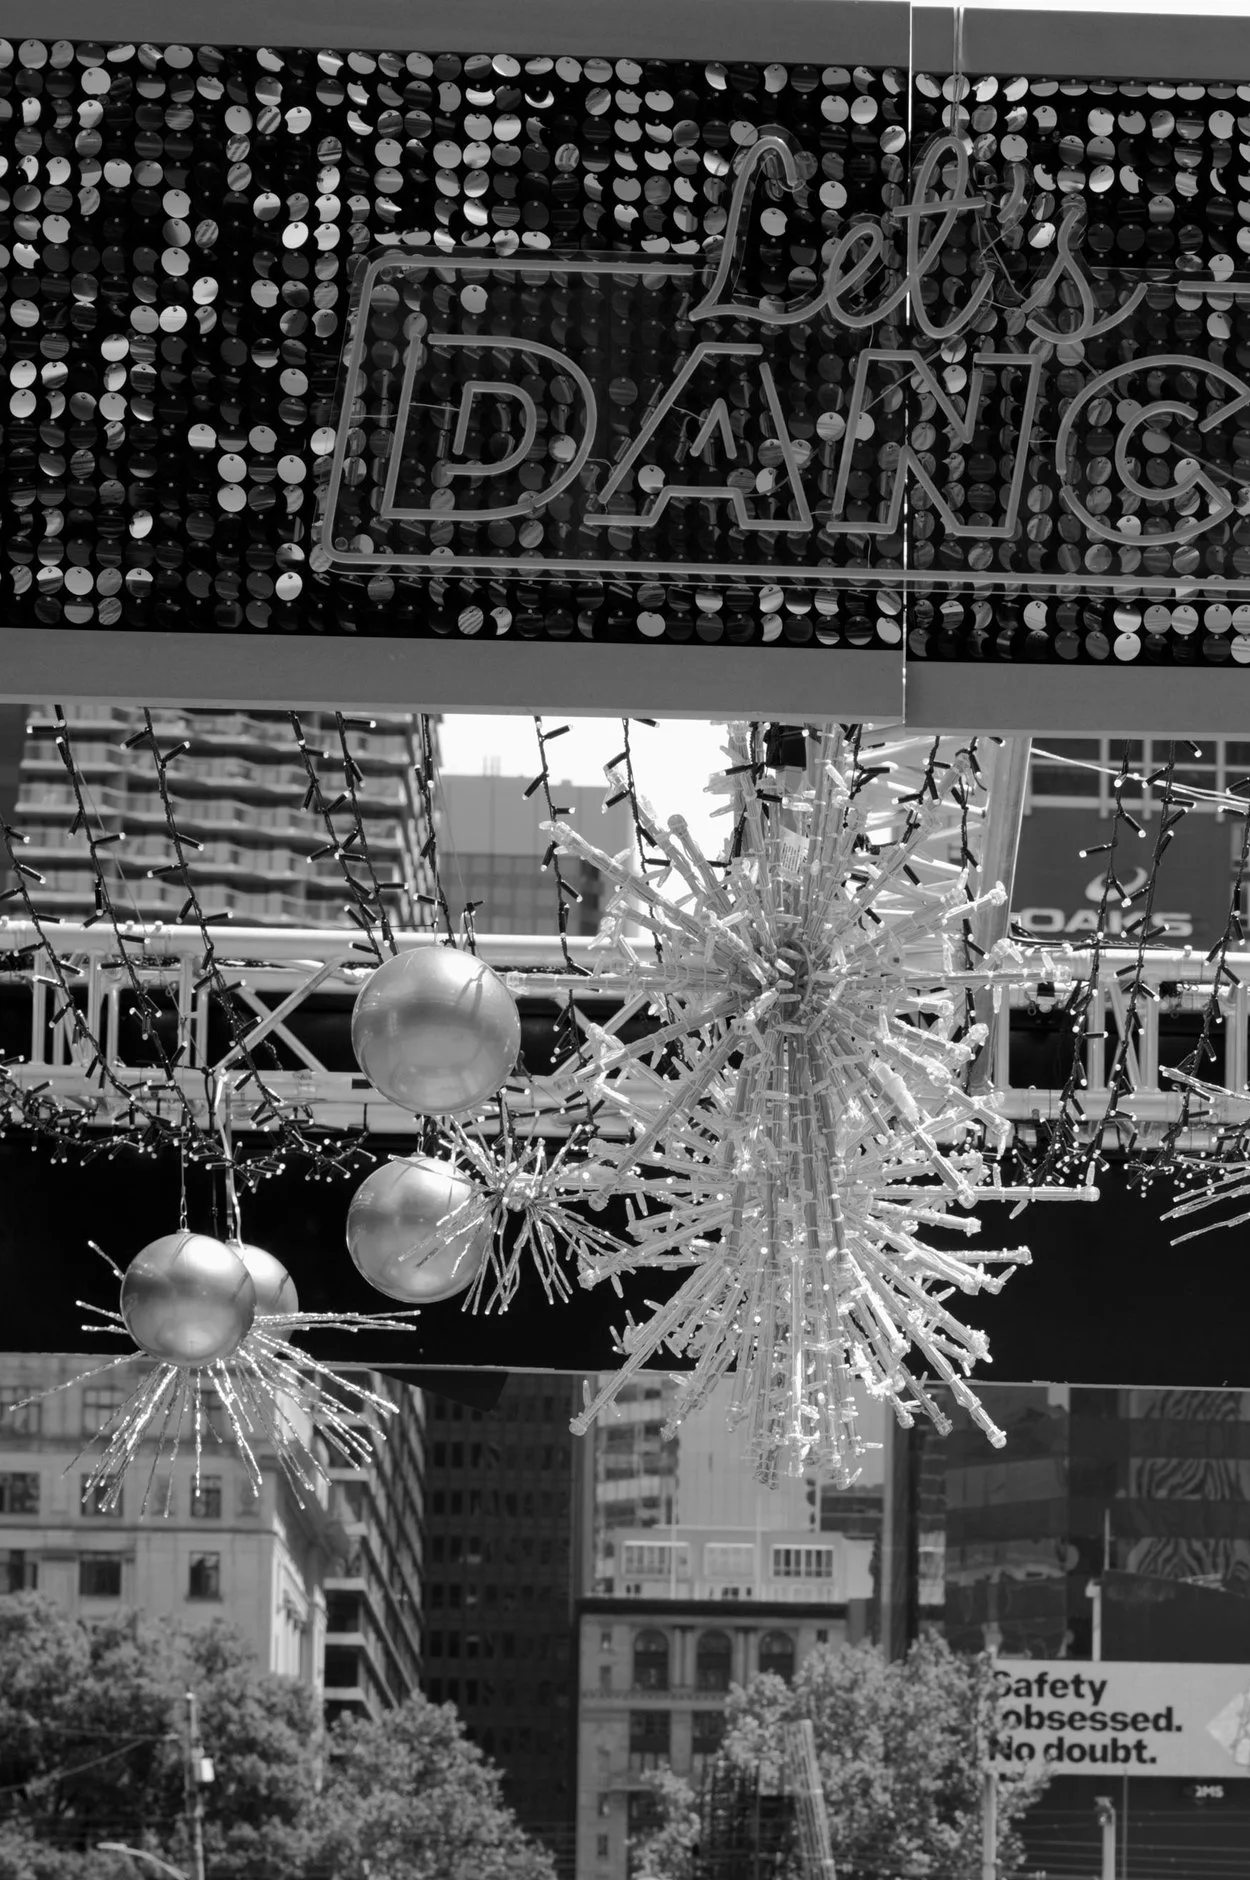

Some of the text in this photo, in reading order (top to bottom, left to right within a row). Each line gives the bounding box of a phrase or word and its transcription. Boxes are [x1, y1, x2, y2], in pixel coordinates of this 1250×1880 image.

[690, 134, 1149, 343] Let's
[1018, 907, 1194, 938] OAKS
[992, 1670, 1108, 1706] Safety
[1001, 1703, 1183, 1732] obsessed.
[1043, 1735, 1157, 1764] doubt.
